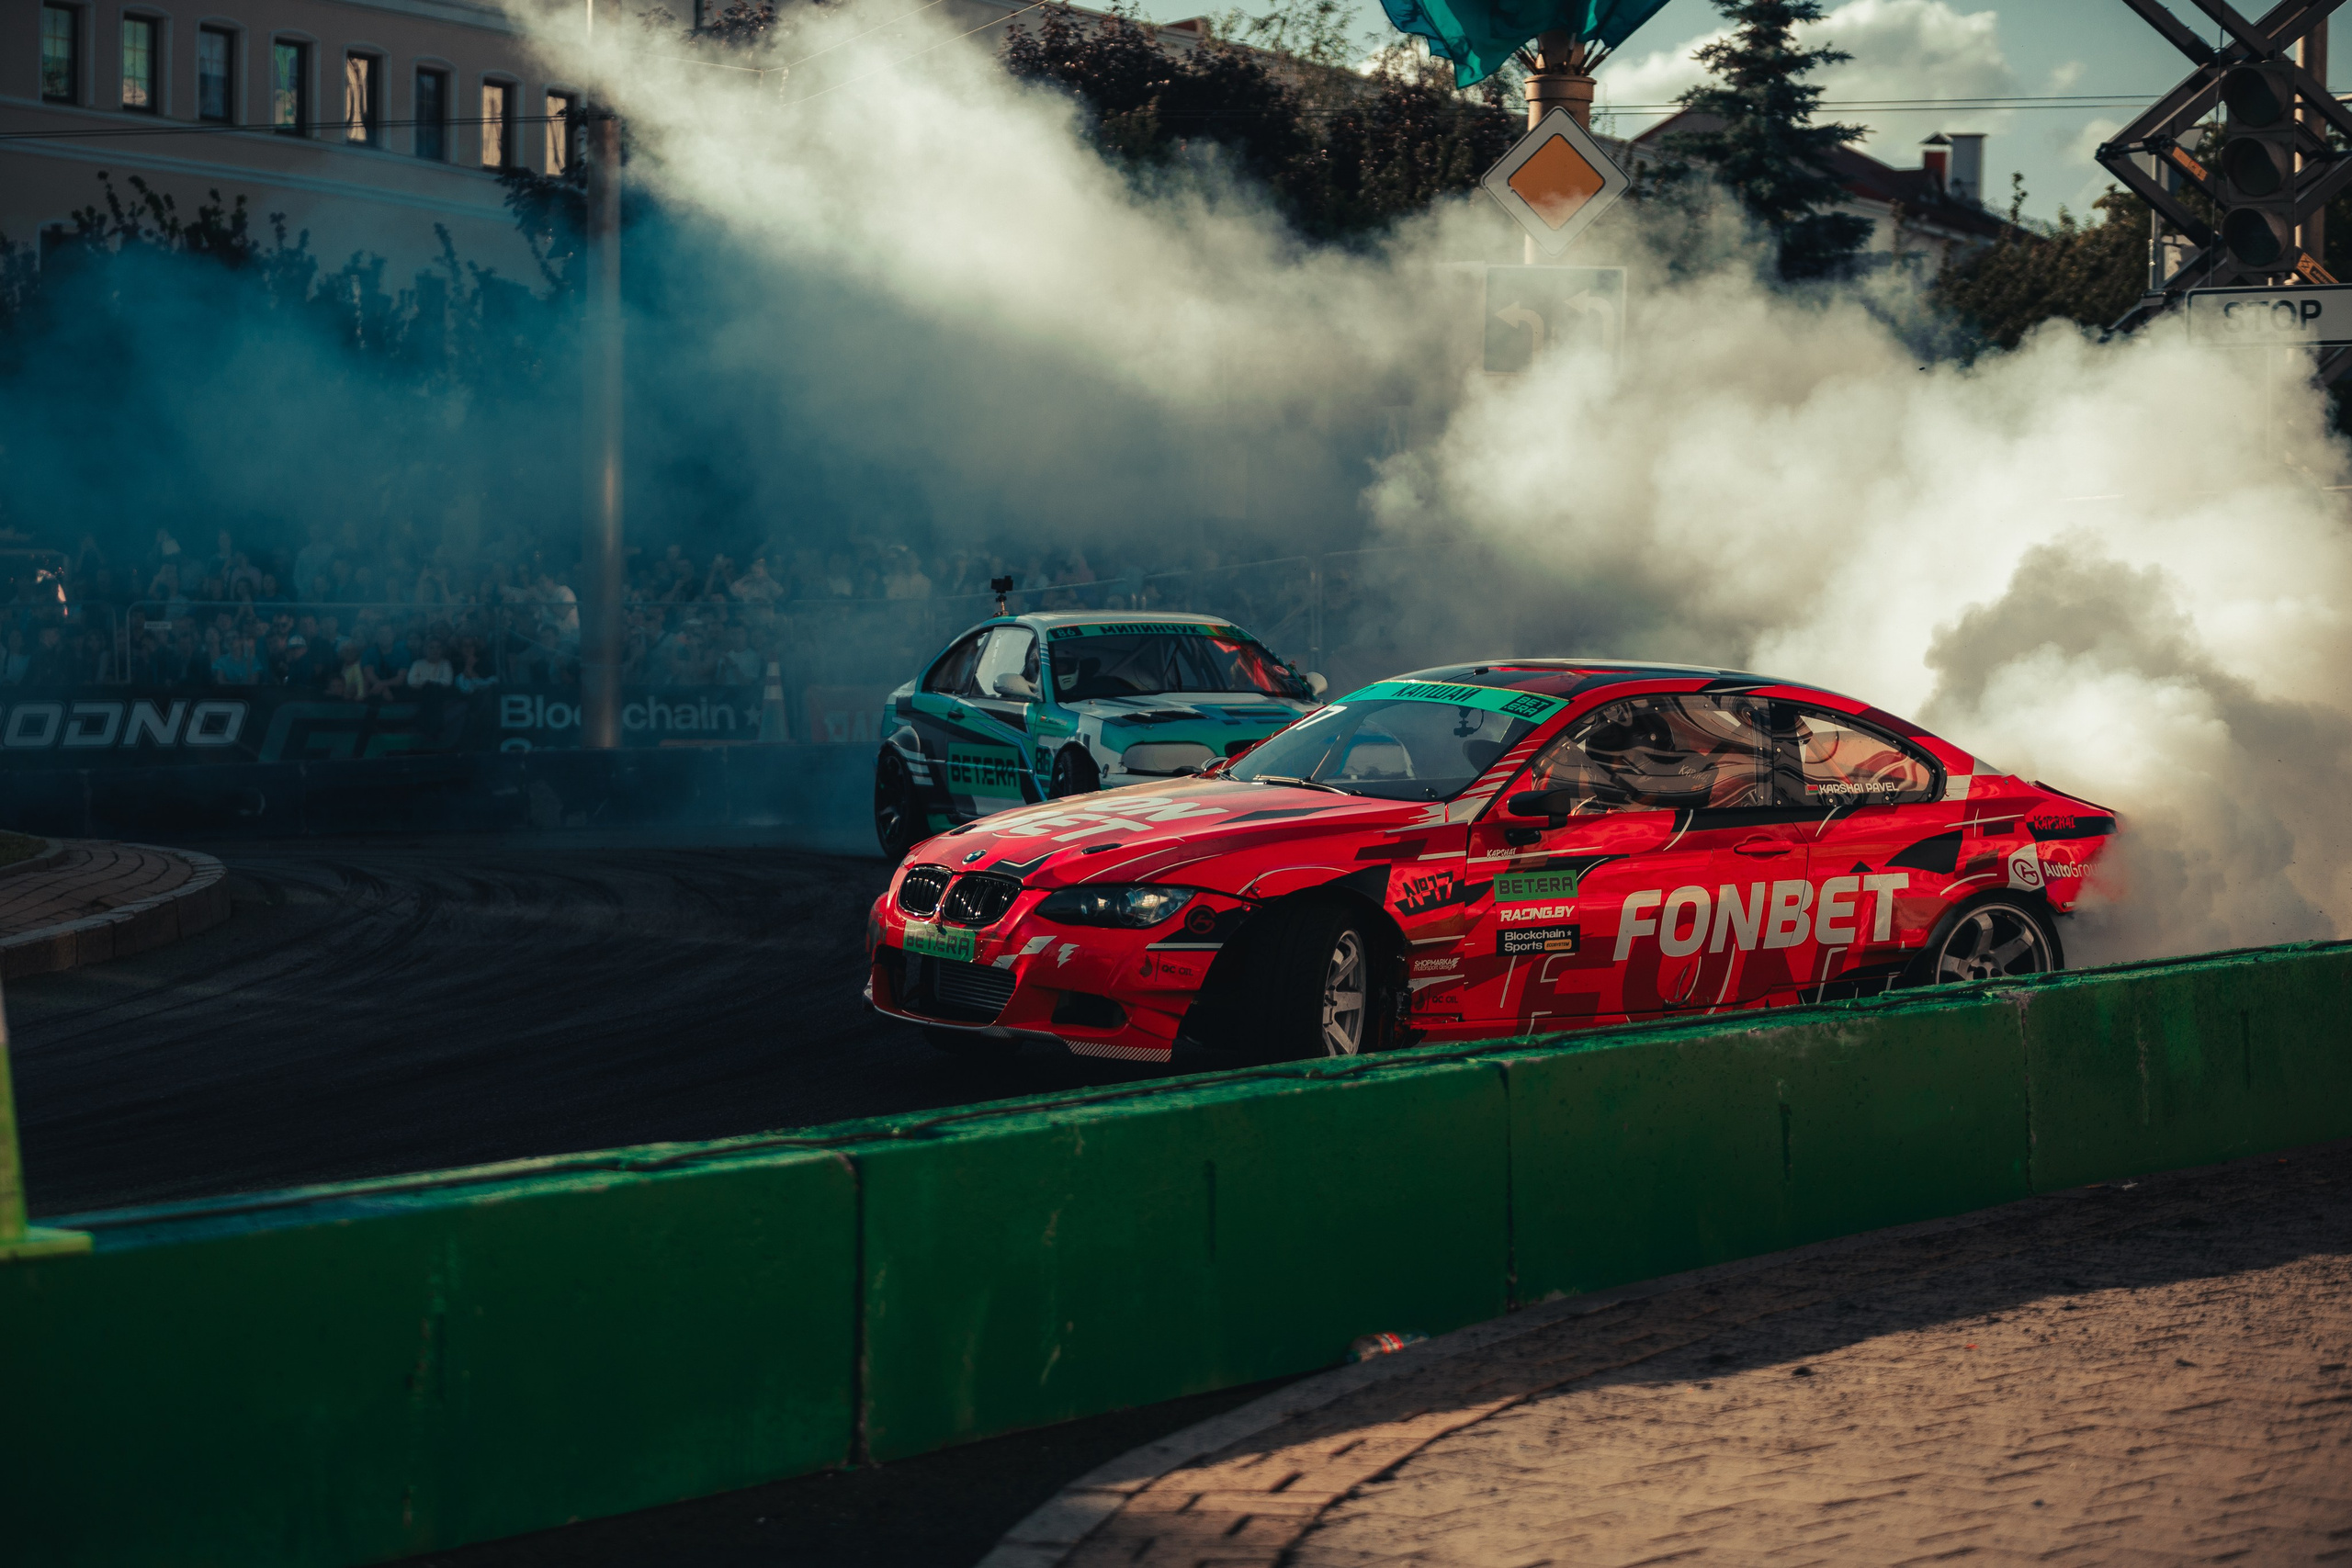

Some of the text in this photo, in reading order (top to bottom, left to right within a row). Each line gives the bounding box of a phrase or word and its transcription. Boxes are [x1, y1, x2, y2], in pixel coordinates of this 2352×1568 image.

[2222, 299, 2323, 333] STOP
[1057, 627, 1077, 637] 86
[1517, 696, 1550, 708] BET
[0, 698, 250, 750] ODNO
[1865, 782, 1899, 793] PAVEL
[2042, 861, 2102, 878] AutoGrou
[1500, 905, 1576, 922] RACING.BY
[1612, 872, 1909, 962] FONBET
[1504, 929, 1566, 942] Blockchain
[1504, 942, 1543, 953] Sports
